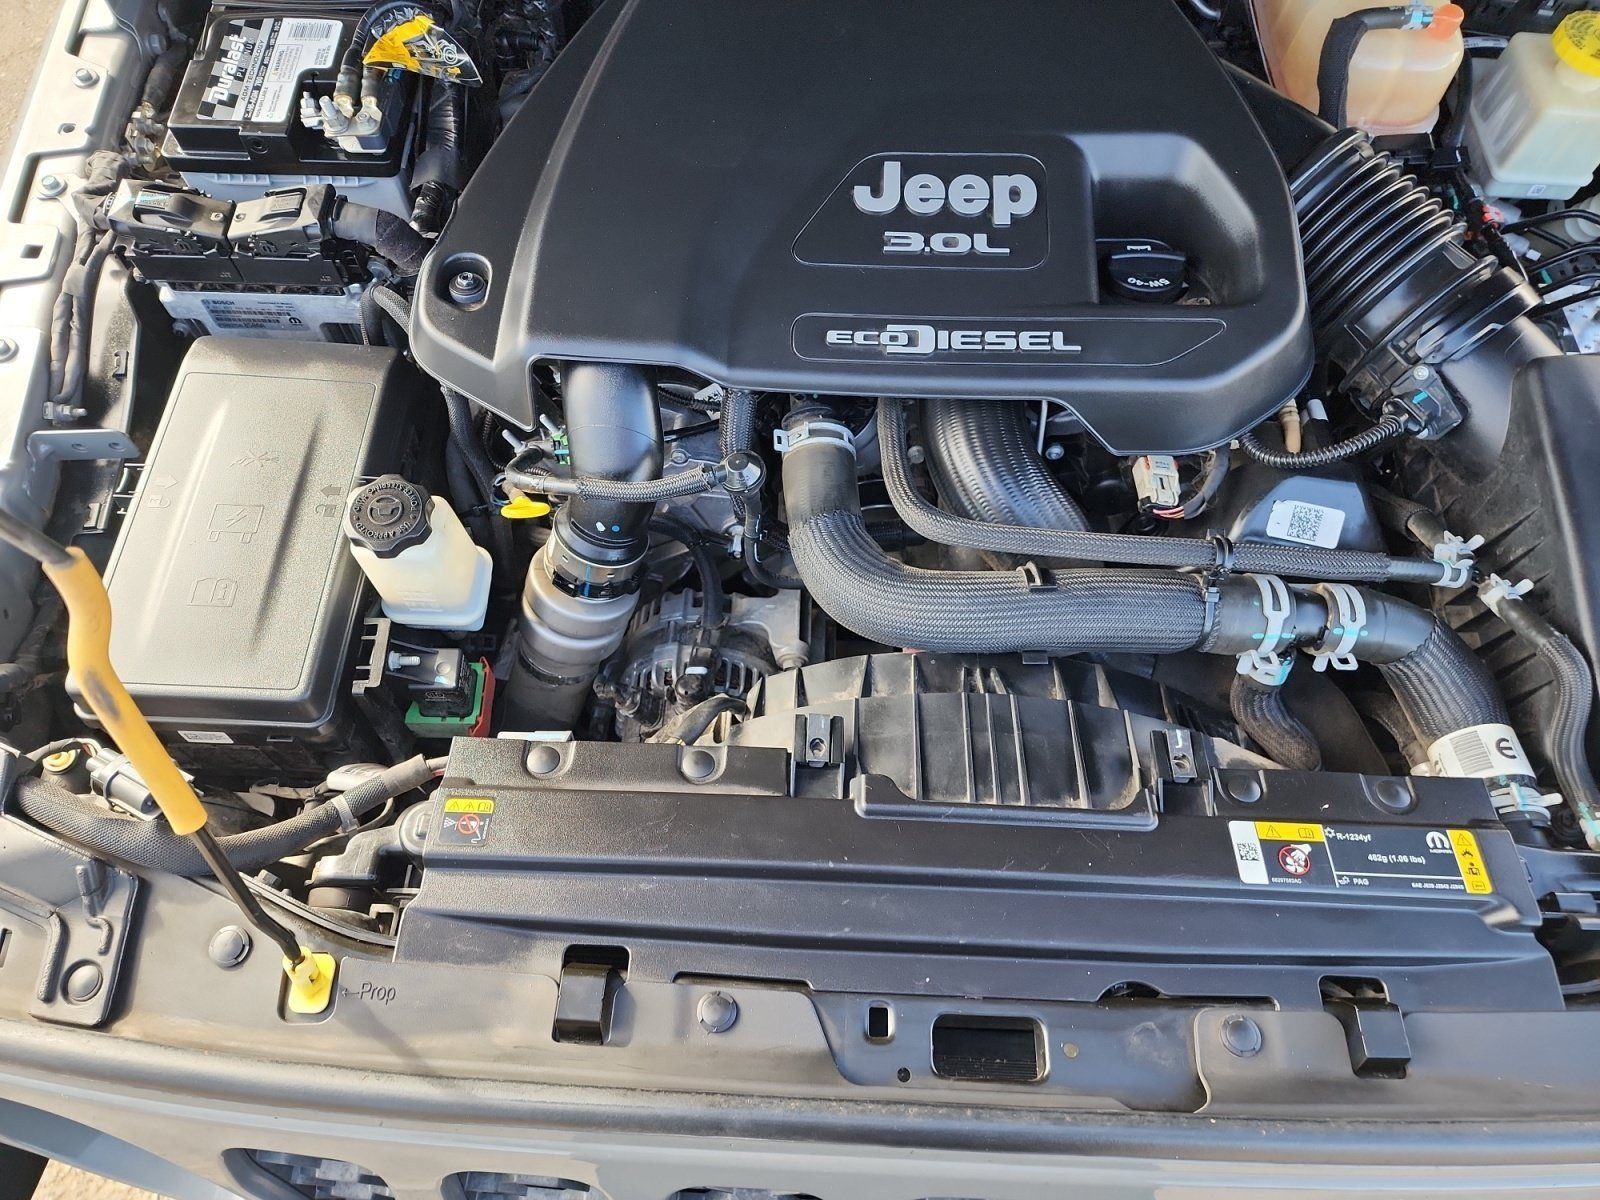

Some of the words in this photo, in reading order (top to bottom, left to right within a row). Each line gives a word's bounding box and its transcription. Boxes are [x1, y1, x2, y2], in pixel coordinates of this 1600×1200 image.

[208, 33, 246, 102] Duralast
[245, 39, 265, 84] TECHNOLOGY
[241, 85, 250, 101] AGM
[853, 161, 1037, 227] Jeep
[883, 231, 1010, 256] 3.0L
[1127, 277, 1171, 288] 5W-40
[355, 522, 396, 539] APPROVED
[397, 521, 412, 534] USE
[1336, 832, 1372, 842] R-1234yf
[1352, 877, 1370, 886] PAG
[360, 981, 397, 1006] Prop
